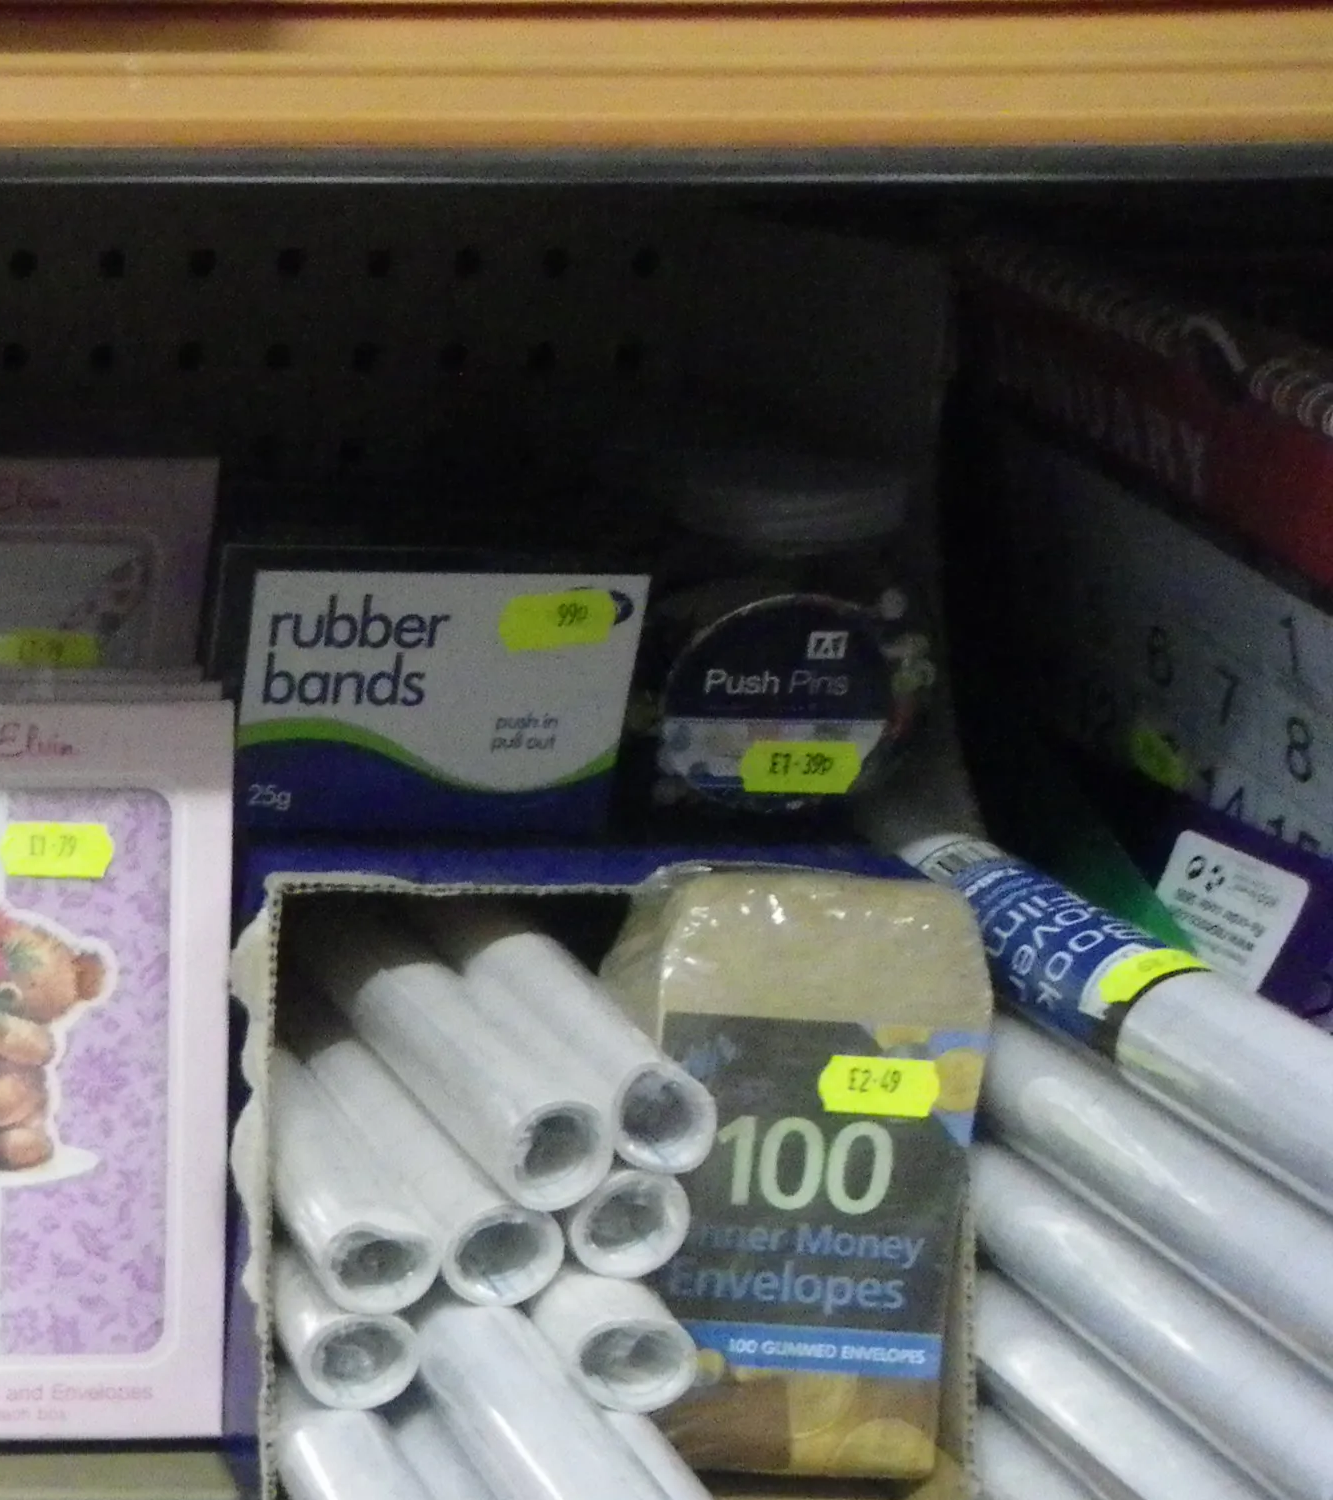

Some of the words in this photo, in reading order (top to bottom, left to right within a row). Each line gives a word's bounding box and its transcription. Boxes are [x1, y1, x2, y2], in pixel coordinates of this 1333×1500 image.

[268, 592, 453, 650] rubber
[262, 651, 427, 706] bands
[704, 667, 781, 696] Push
[789, 668, 850, 697] Pins
[493, 714, 540, 732] push
[247, 782, 292, 812] 25g
[716, 1114, 894, 1215] 100
[794, 1223, 925, 1268] Money
[669, 1252, 906, 1315] Envelopes
[761, 1339, 835, 1360] GUMMED
[840, 1342, 926, 1366] ENVELOPES
[5, 1384, 43, 1400] and
[51, 1383, 154, 1405] Envelopes
